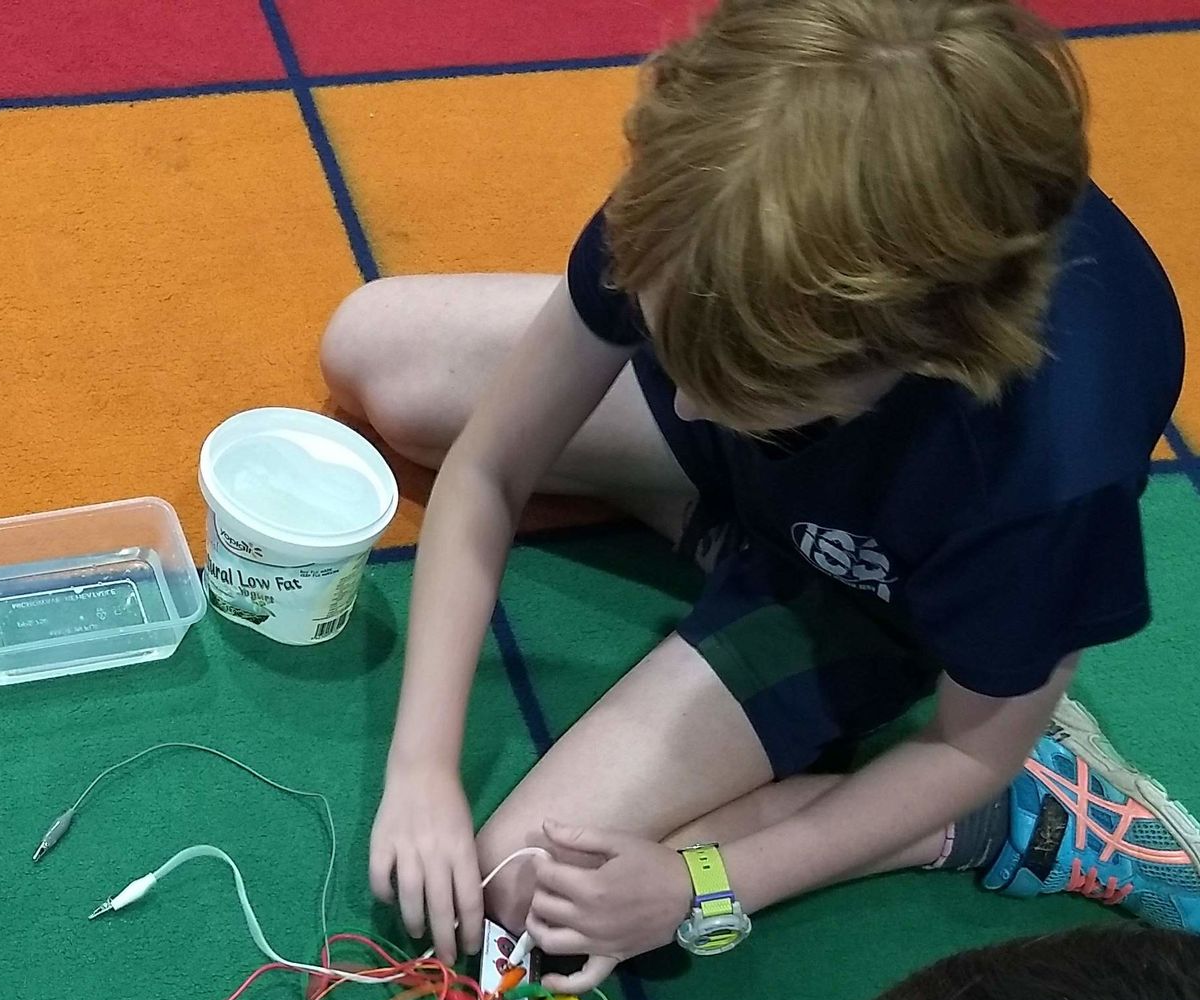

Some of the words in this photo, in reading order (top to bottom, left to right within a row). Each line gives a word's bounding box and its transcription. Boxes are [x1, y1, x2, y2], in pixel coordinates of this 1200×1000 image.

[208, 557, 233, 585] ural
[237, 570, 270, 590] Low
[275, 577, 302, 591] Fat
